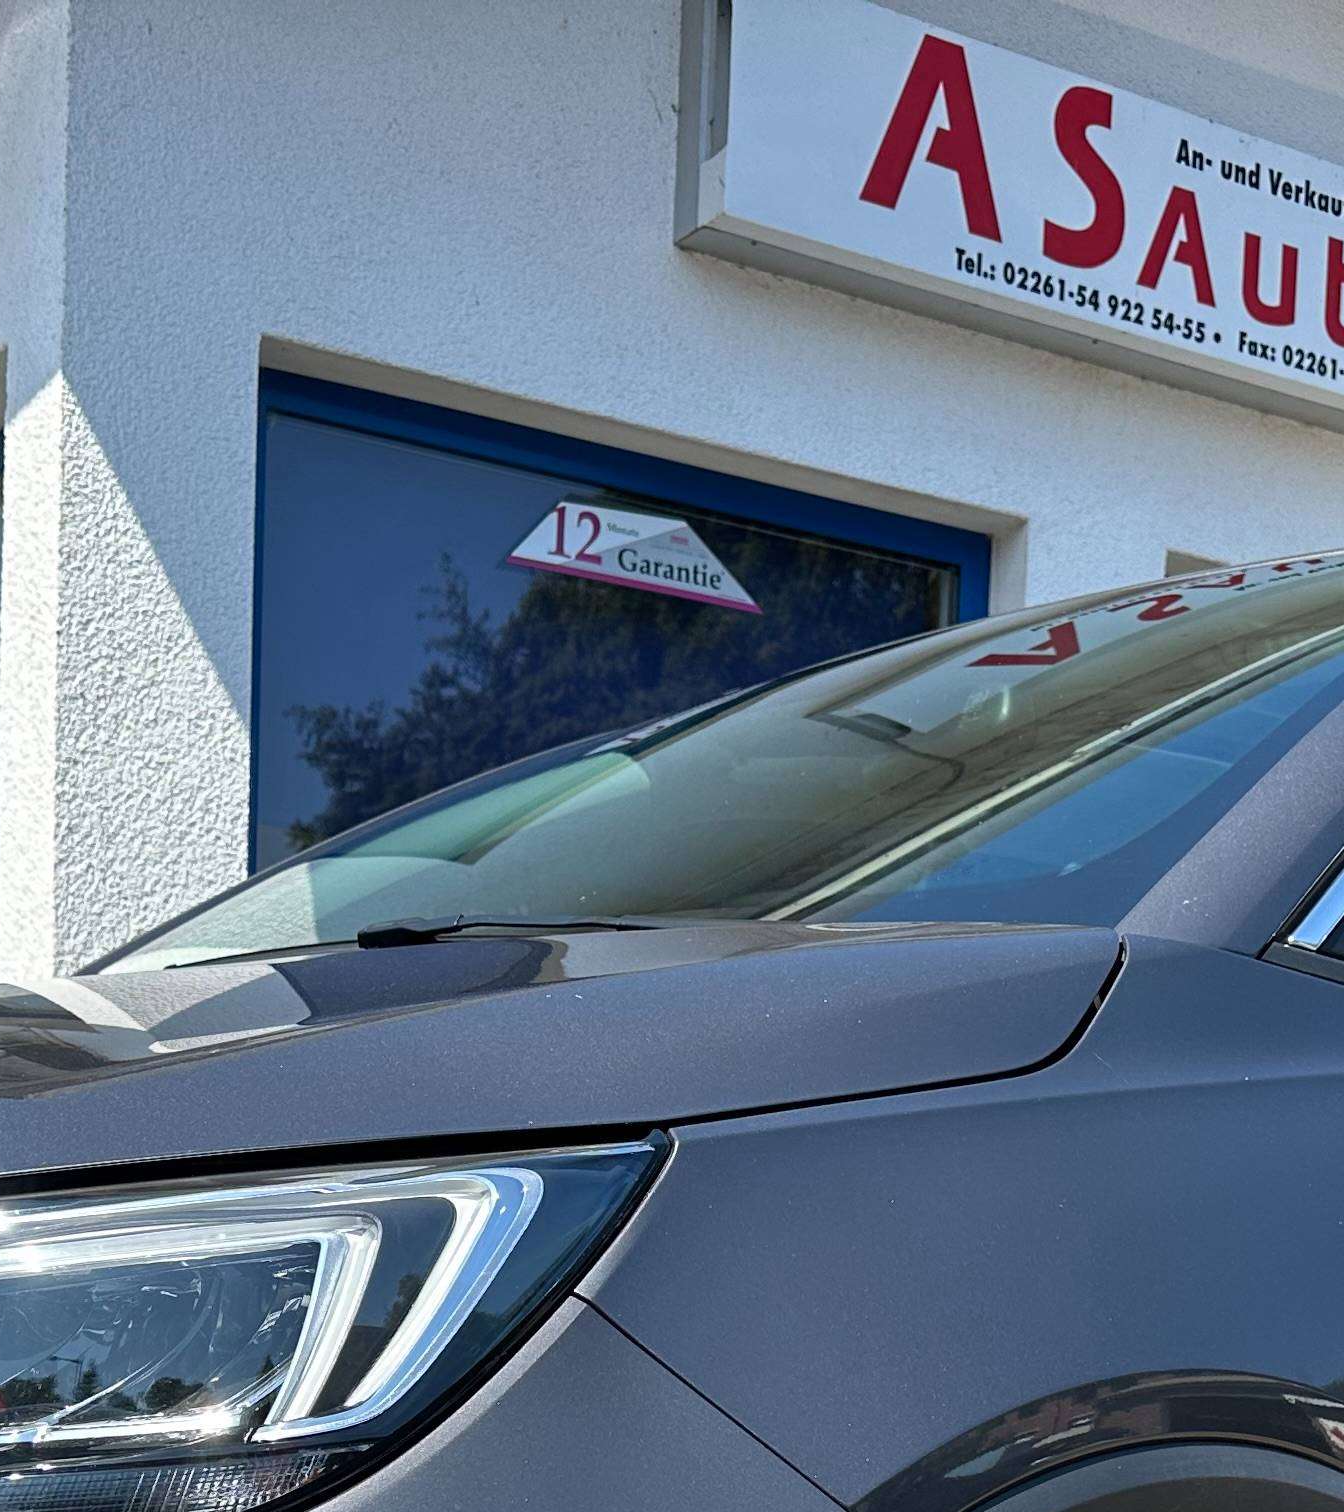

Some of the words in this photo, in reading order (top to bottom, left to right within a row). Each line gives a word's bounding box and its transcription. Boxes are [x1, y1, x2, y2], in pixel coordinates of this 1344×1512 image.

[1175, 138, 1212, 171] An-
[1220, 160, 1260, 190] und
[955, 247, 996, 281] Tel.:
[1002, 261, 1100, 312] 02261-54
[1108, 294, 1145, 325] 922
[1151, 308, 1206, 344] 54-55
[1238, 331, 1277, 362] Fax:
[547, 504, 603, 566] 12
[617, 547, 723, 591] Garantie
